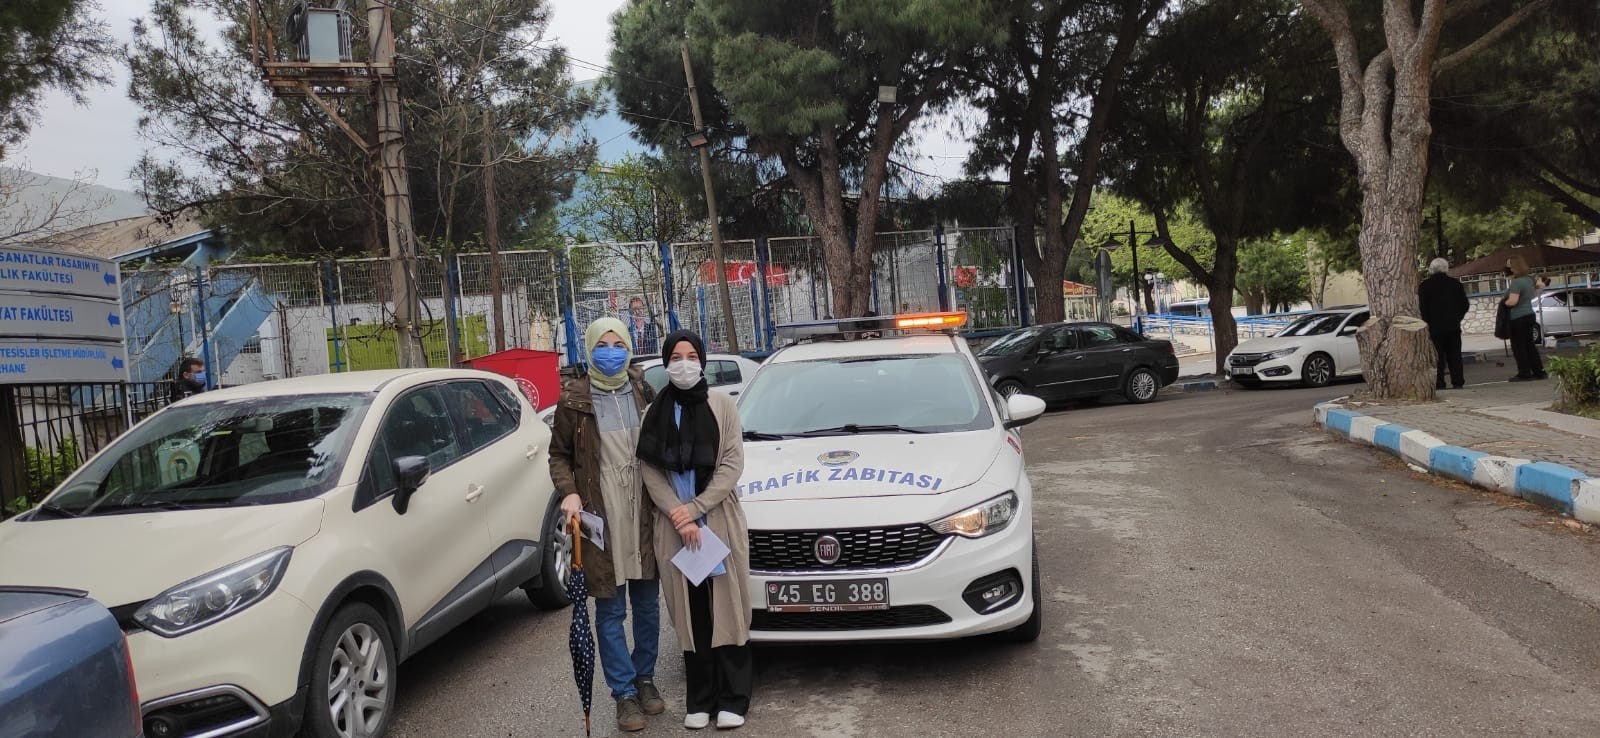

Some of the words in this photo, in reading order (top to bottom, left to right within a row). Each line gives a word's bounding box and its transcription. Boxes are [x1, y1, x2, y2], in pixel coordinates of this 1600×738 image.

[0, 252, 54, 266] SANATLAR
[0, 269, 19, 280] LIK
[22, 269, 74, 284] FAKÜLTESİ
[20, 305, 74, 322] FAKÜLTESİ
[736, 469, 820, 497] TRAFİK
[828, 467, 943, 491] ZABITASI
[820, 544, 835, 557] FIAT
[778, 585, 801, 604] 45
[812, 584, 836, 603] EG
[848, 582, 884, 602] 388
